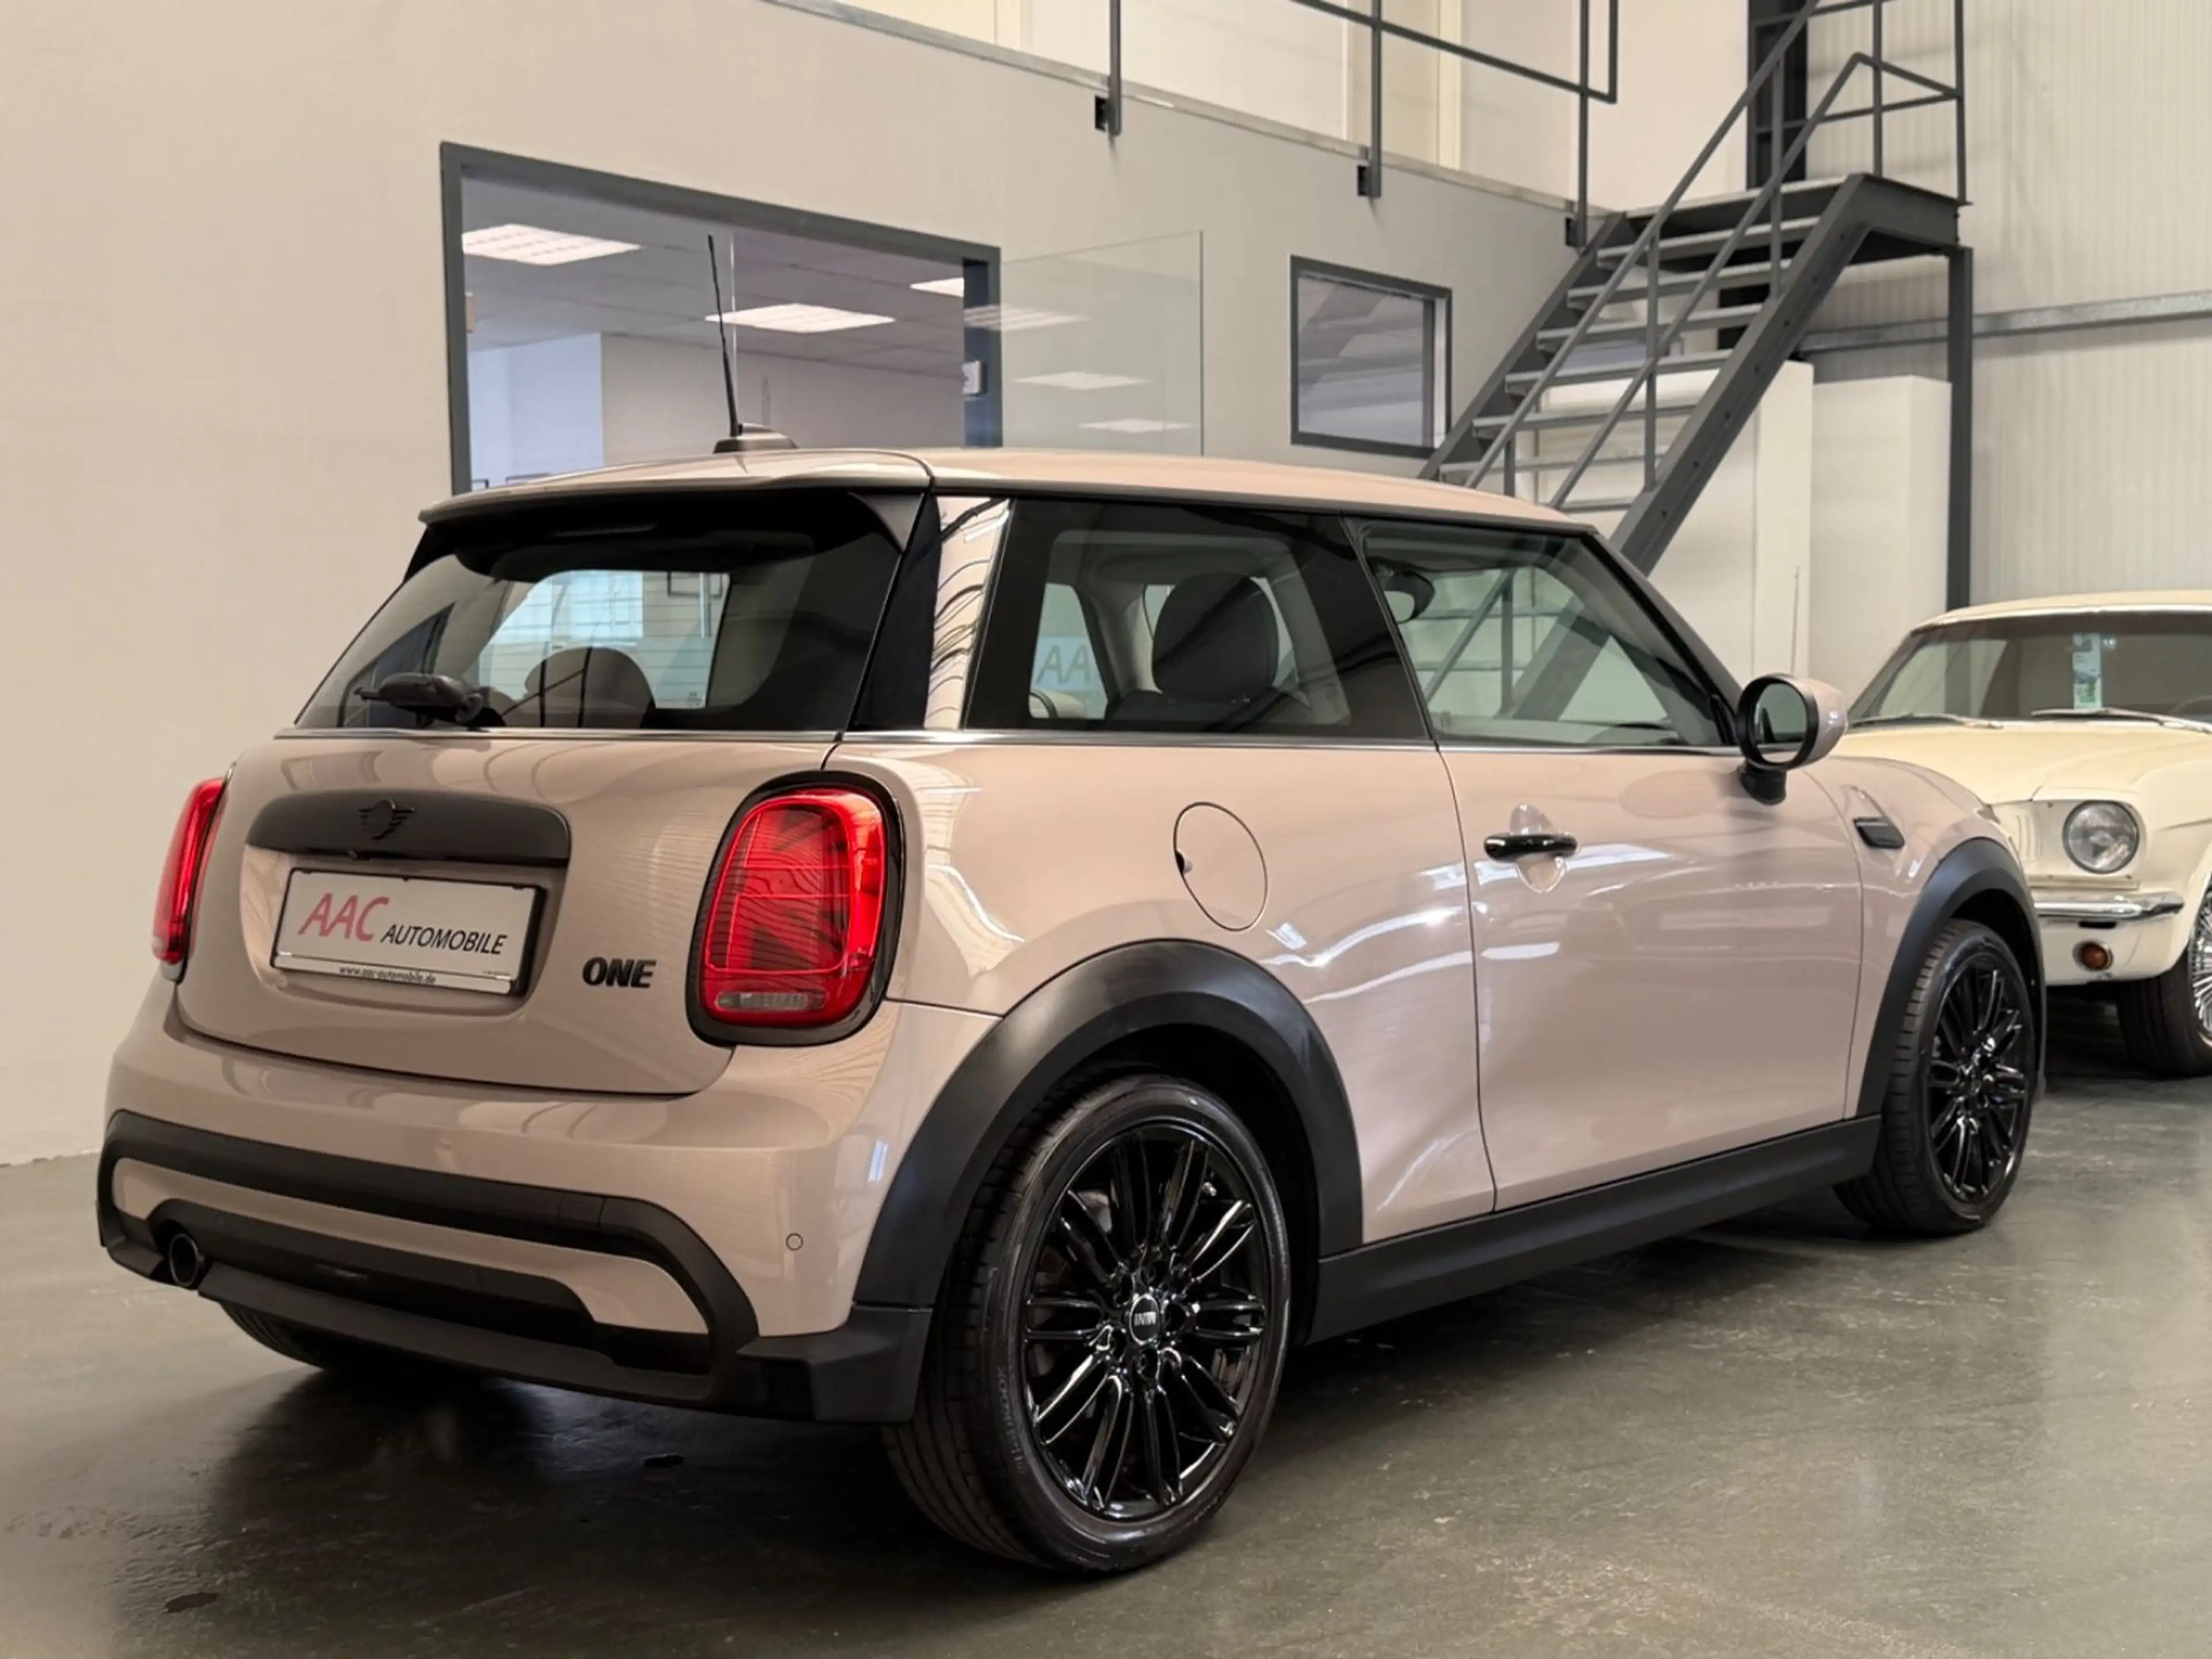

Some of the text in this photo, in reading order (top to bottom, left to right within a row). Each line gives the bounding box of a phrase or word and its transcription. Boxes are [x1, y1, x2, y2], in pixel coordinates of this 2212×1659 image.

[297, 892, 507, 955] AAC AUTOMOBILE
[582, 956, 657, 988] ONE
